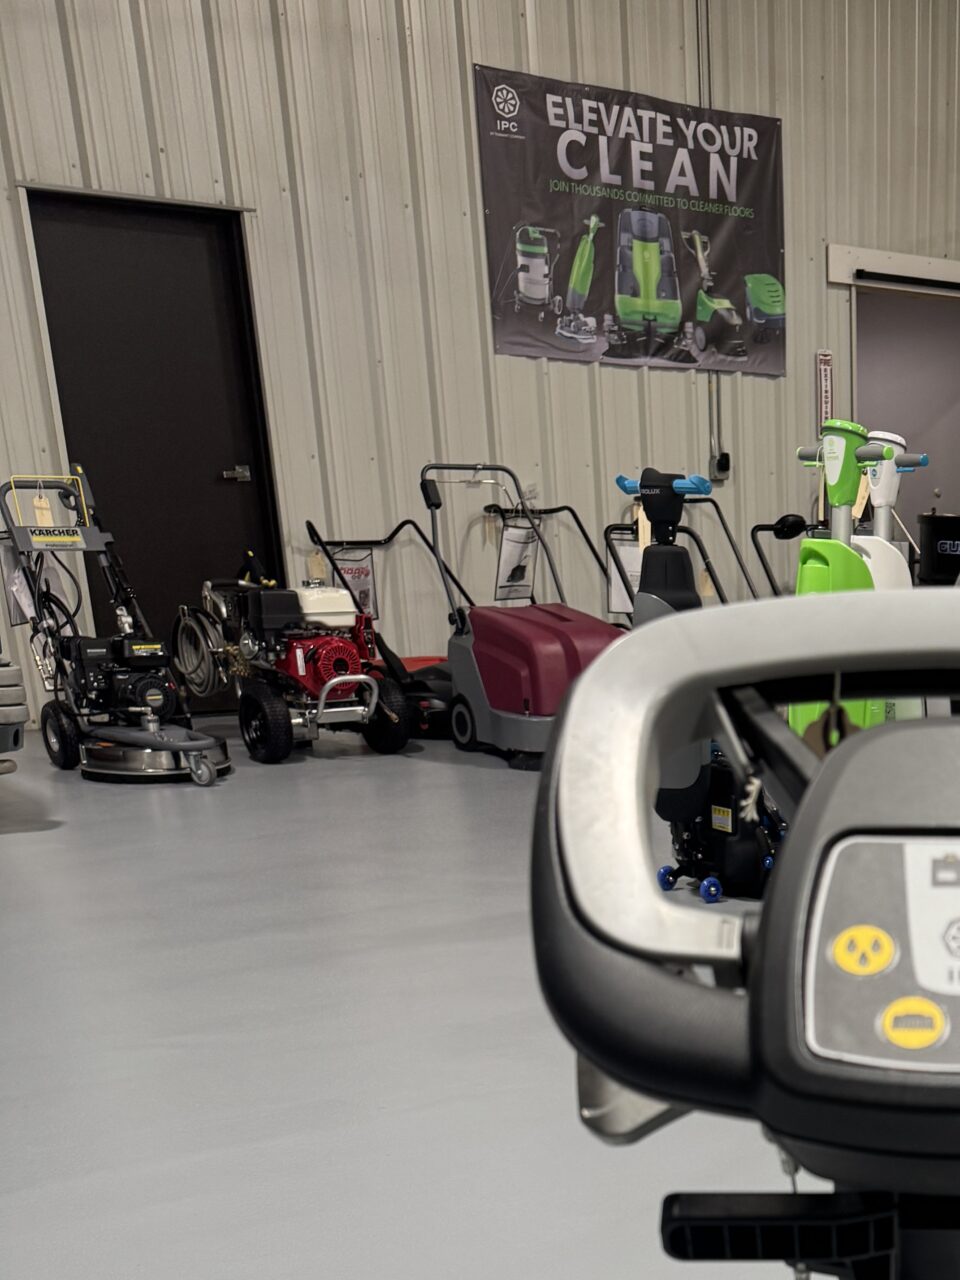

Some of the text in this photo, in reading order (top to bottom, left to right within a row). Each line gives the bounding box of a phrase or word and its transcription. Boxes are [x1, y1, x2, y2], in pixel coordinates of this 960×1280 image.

[497, 119, 518, 132] IPC
[546, 93, 758, 160] ELEVATE YOUR
[556, 129, 737, 202] CLEAN
[550, 179, 755, 219] JOIN THOUSANDS COMMITTED TO CLEANER FLOORS
